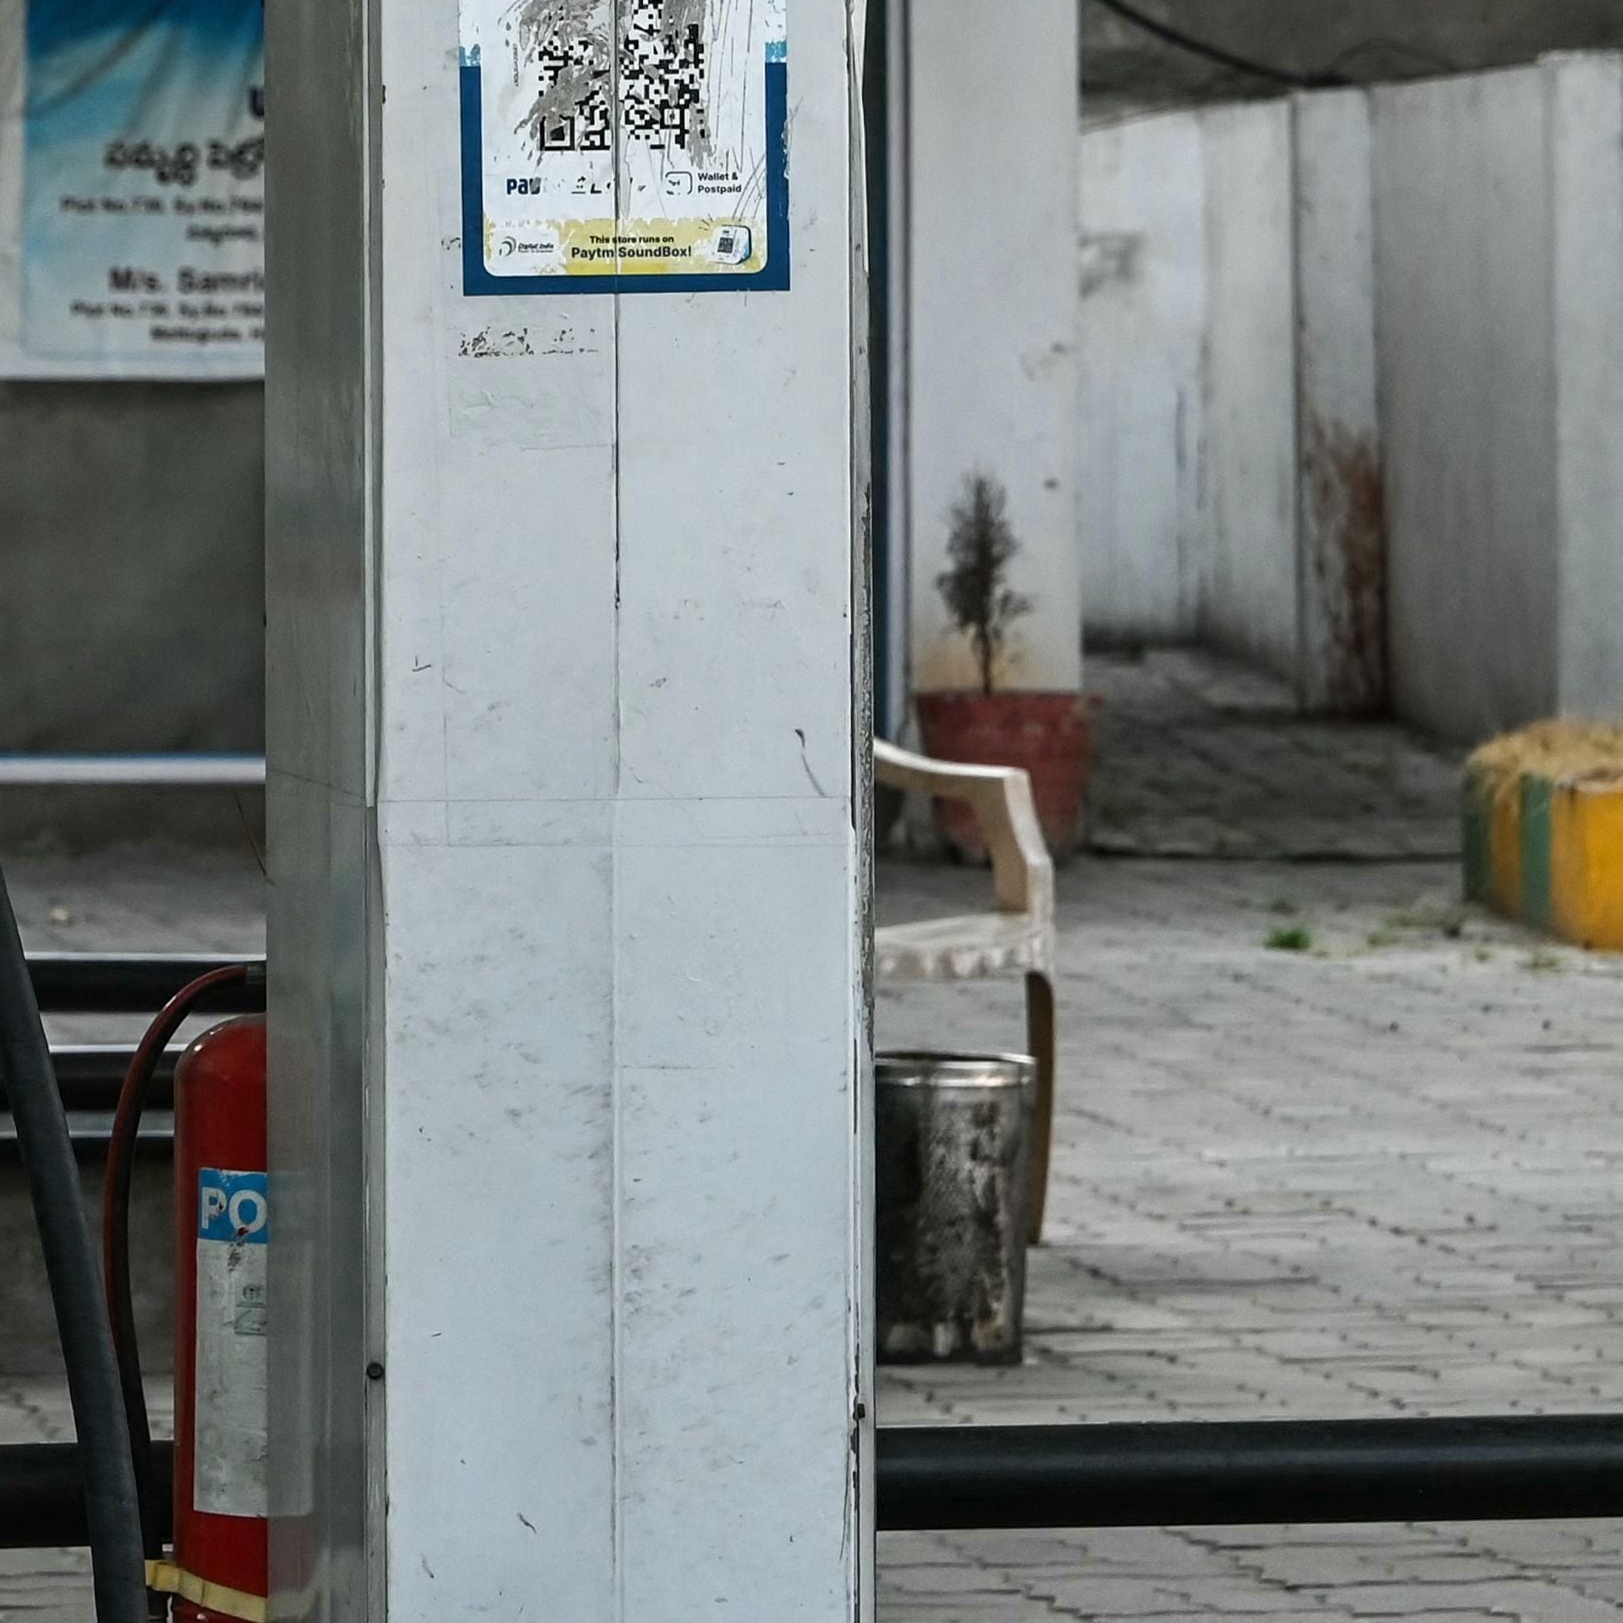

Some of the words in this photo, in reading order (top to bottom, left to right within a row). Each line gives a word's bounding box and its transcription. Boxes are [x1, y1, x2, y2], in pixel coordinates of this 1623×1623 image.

[697, 172, 729, 182] Wallet
[697, 184, 742, 195] Postpaid
[589, 235, 610, 244] This
[612, 235, 637, 244] store
[638, 236, 661, 244] runs
[662, 236, 675, 244] on
[571, 246, 615, 261] Paytm
[618, 245, 692, 259] SoundBox!
